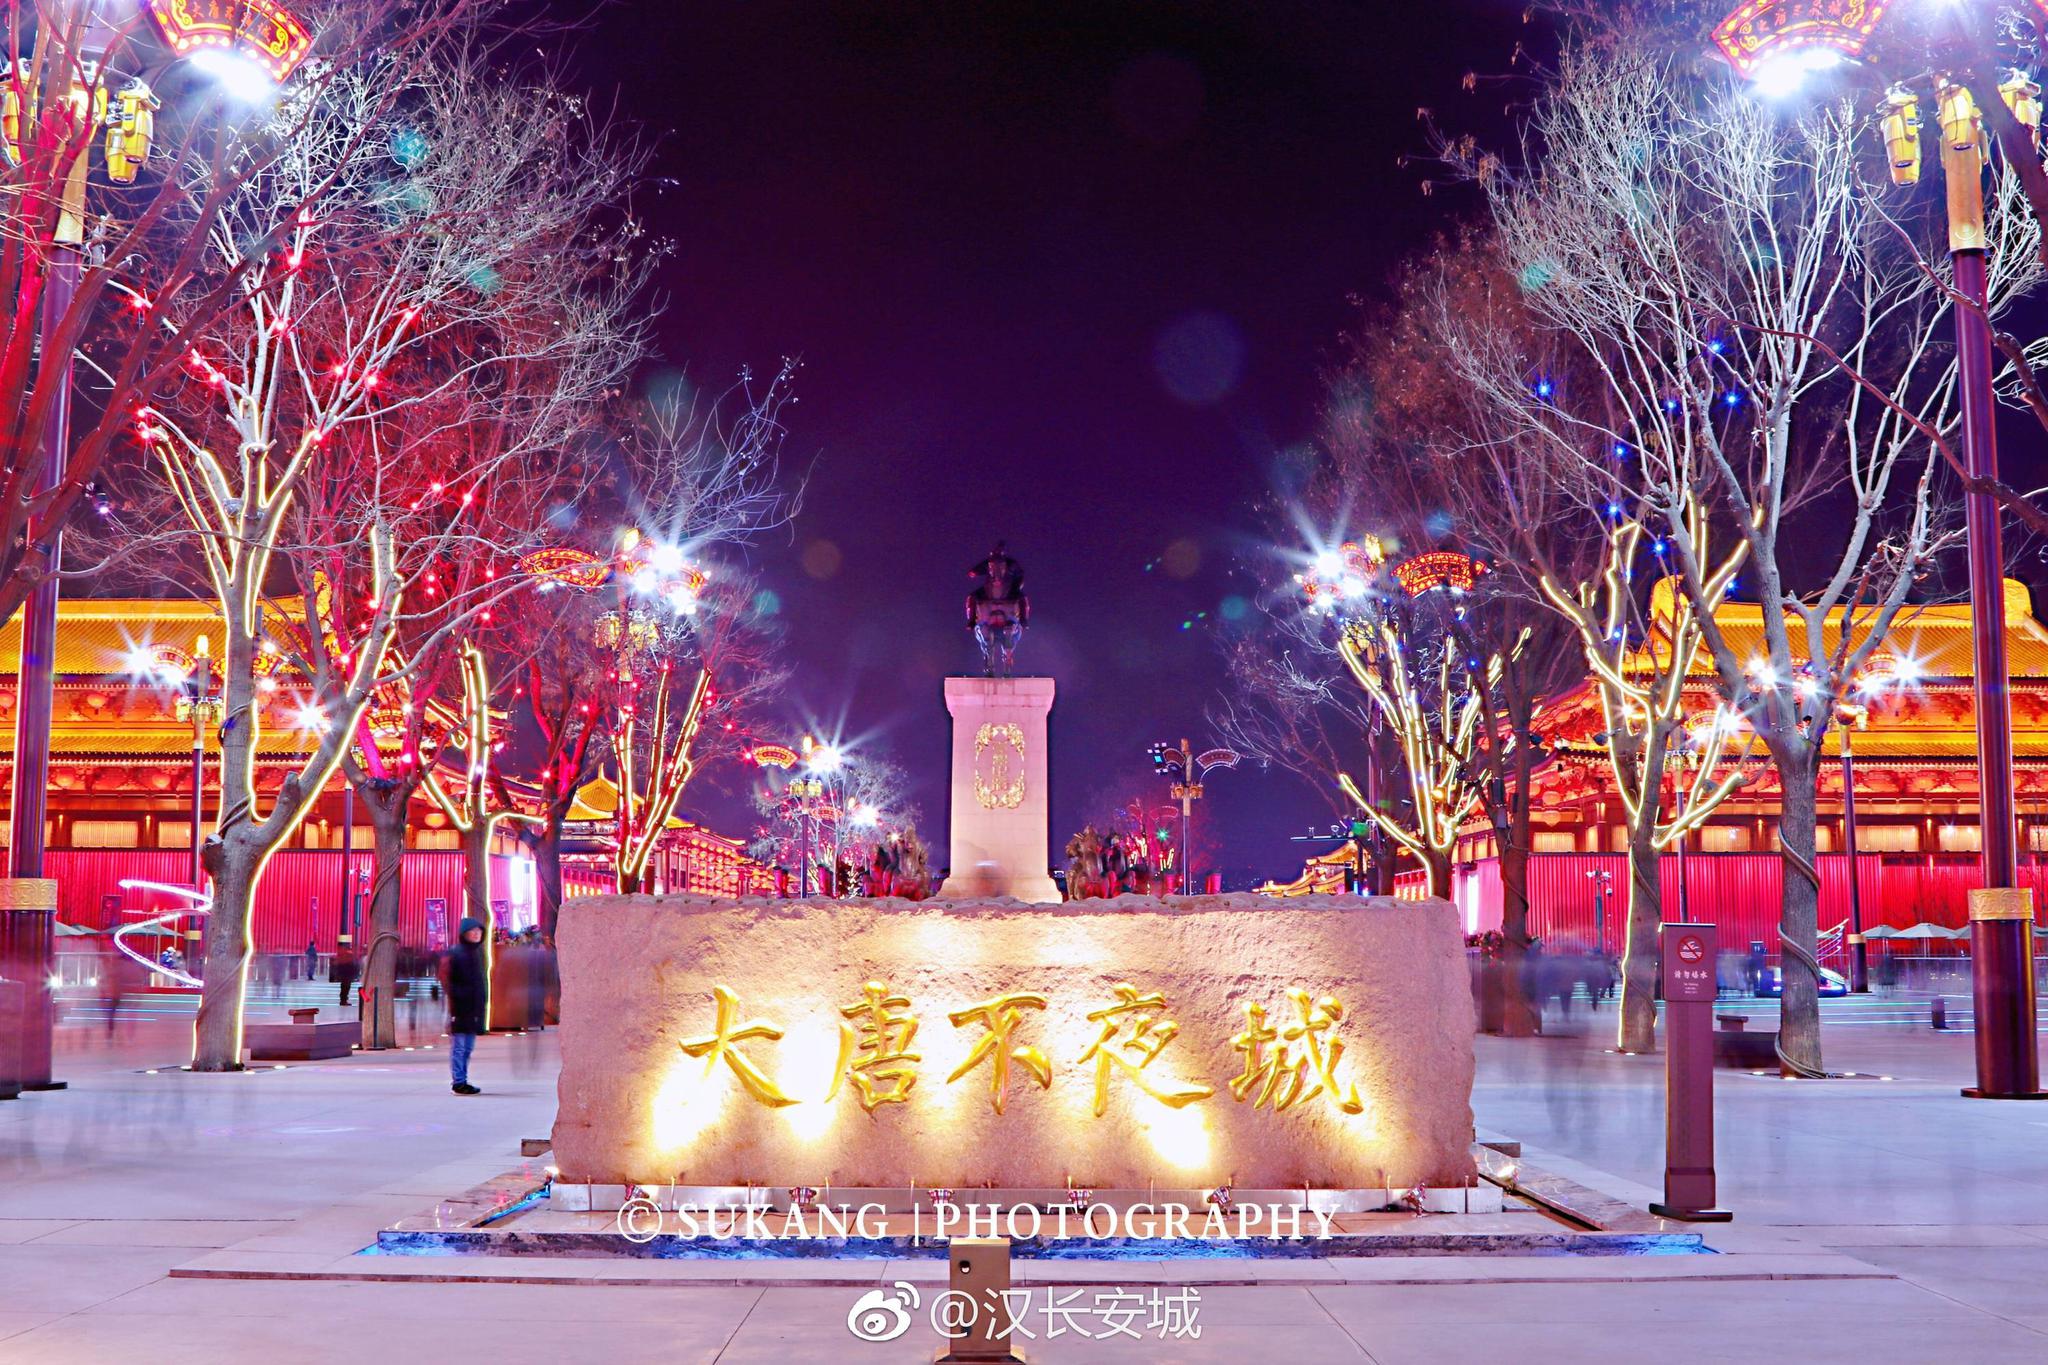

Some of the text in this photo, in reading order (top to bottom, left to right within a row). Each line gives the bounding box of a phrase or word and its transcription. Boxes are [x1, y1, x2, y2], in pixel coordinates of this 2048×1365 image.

[679, 981, 1364, 1116] 大唐不夜城
